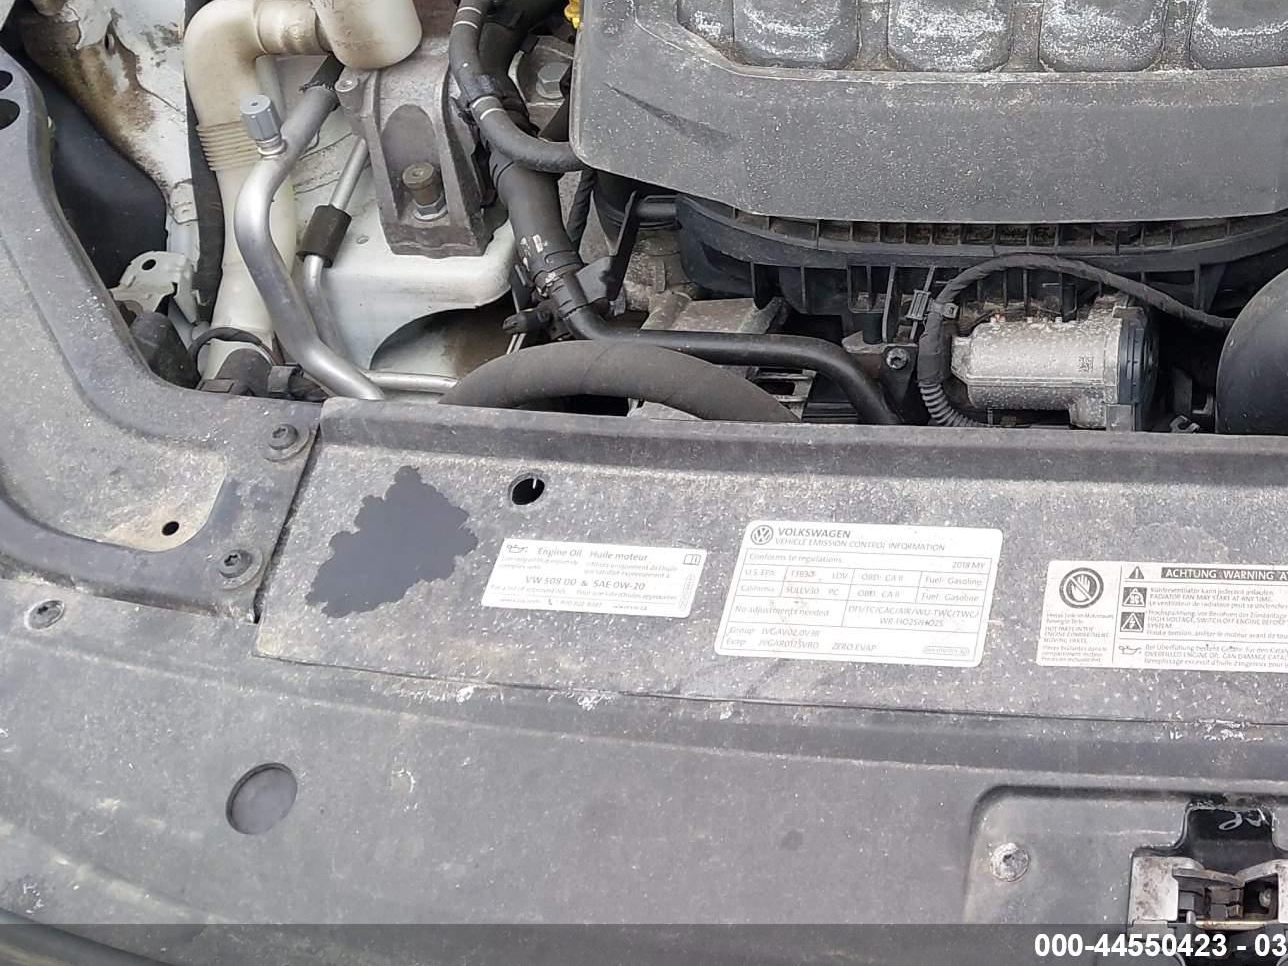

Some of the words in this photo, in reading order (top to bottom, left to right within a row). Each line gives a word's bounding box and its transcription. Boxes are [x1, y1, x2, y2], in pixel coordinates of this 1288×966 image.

[778, 527, 851, 538] VOLKSWAGEN
[775, 538, 806, 546] VEHICLE
[808, 539, 847, 547] EMISSION
[889, 542, 945, 552] INFORMATION
[537, 547, 568, 558] Engine
[570, 549, 582, 557] Oil
[590, 550, 613, 559] Huile
[616, 553, 648, 561] moteur
[1166, 569, 1216, 578] ACHTUNG
[1223, 570, 1274, 580] WARNING
[526, 576, 543, 584] VW
[563, 578, 576, 586] 00
[613, 581, 646, 590] 0W-20
[947, 578, 982, 586] Gasoline
[944, 593, 980, 602] Gasoline
[799, 608, 829, 617] needed
